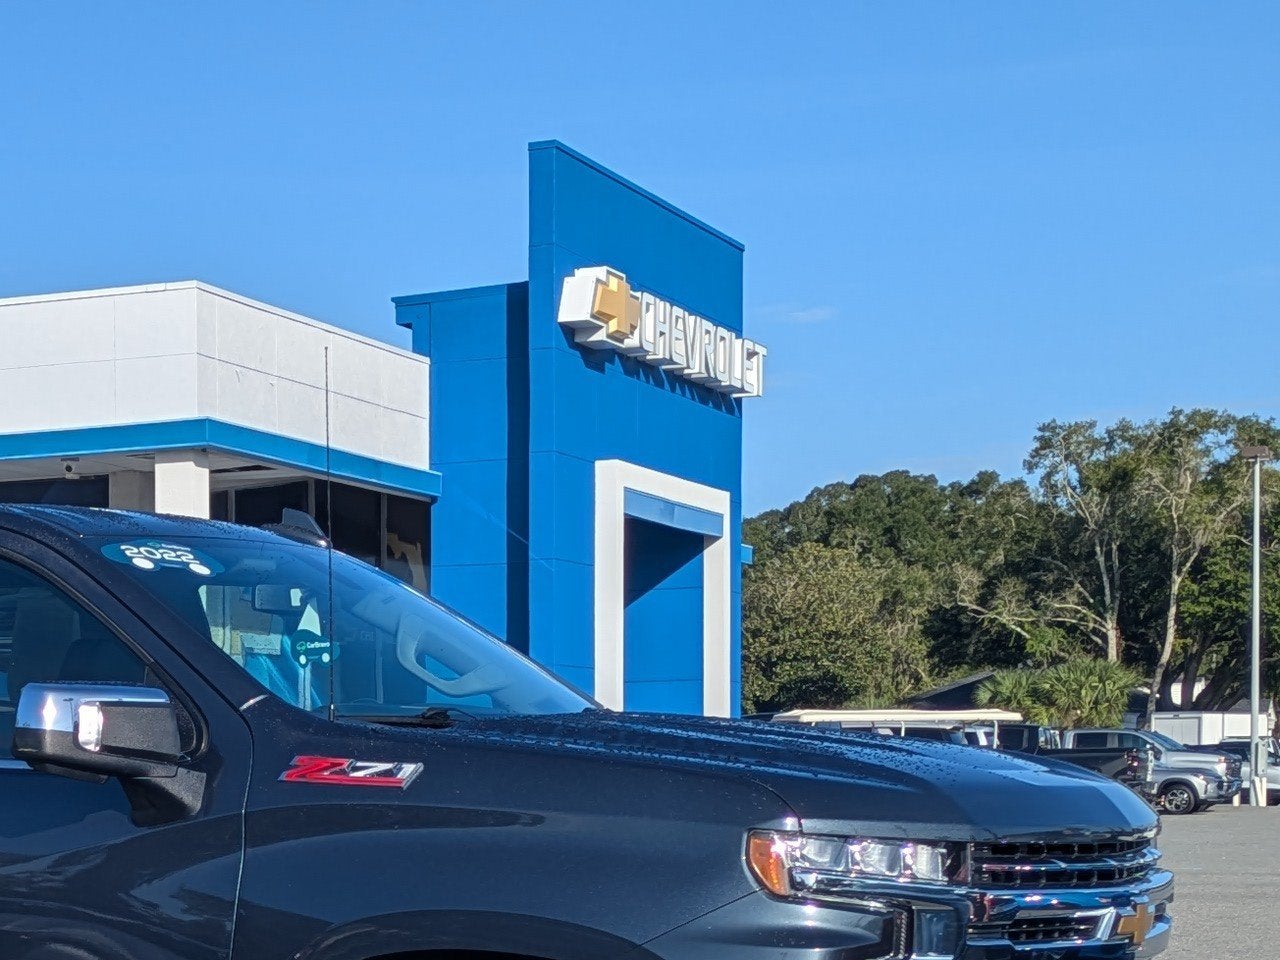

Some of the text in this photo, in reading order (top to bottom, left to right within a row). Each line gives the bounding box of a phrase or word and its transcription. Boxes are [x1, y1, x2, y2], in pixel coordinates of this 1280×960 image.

[641, 291, 767, 398] CHEVROLET
[120, 545, 200, 564] 2022
[277, 755, 424, 790] Z71
